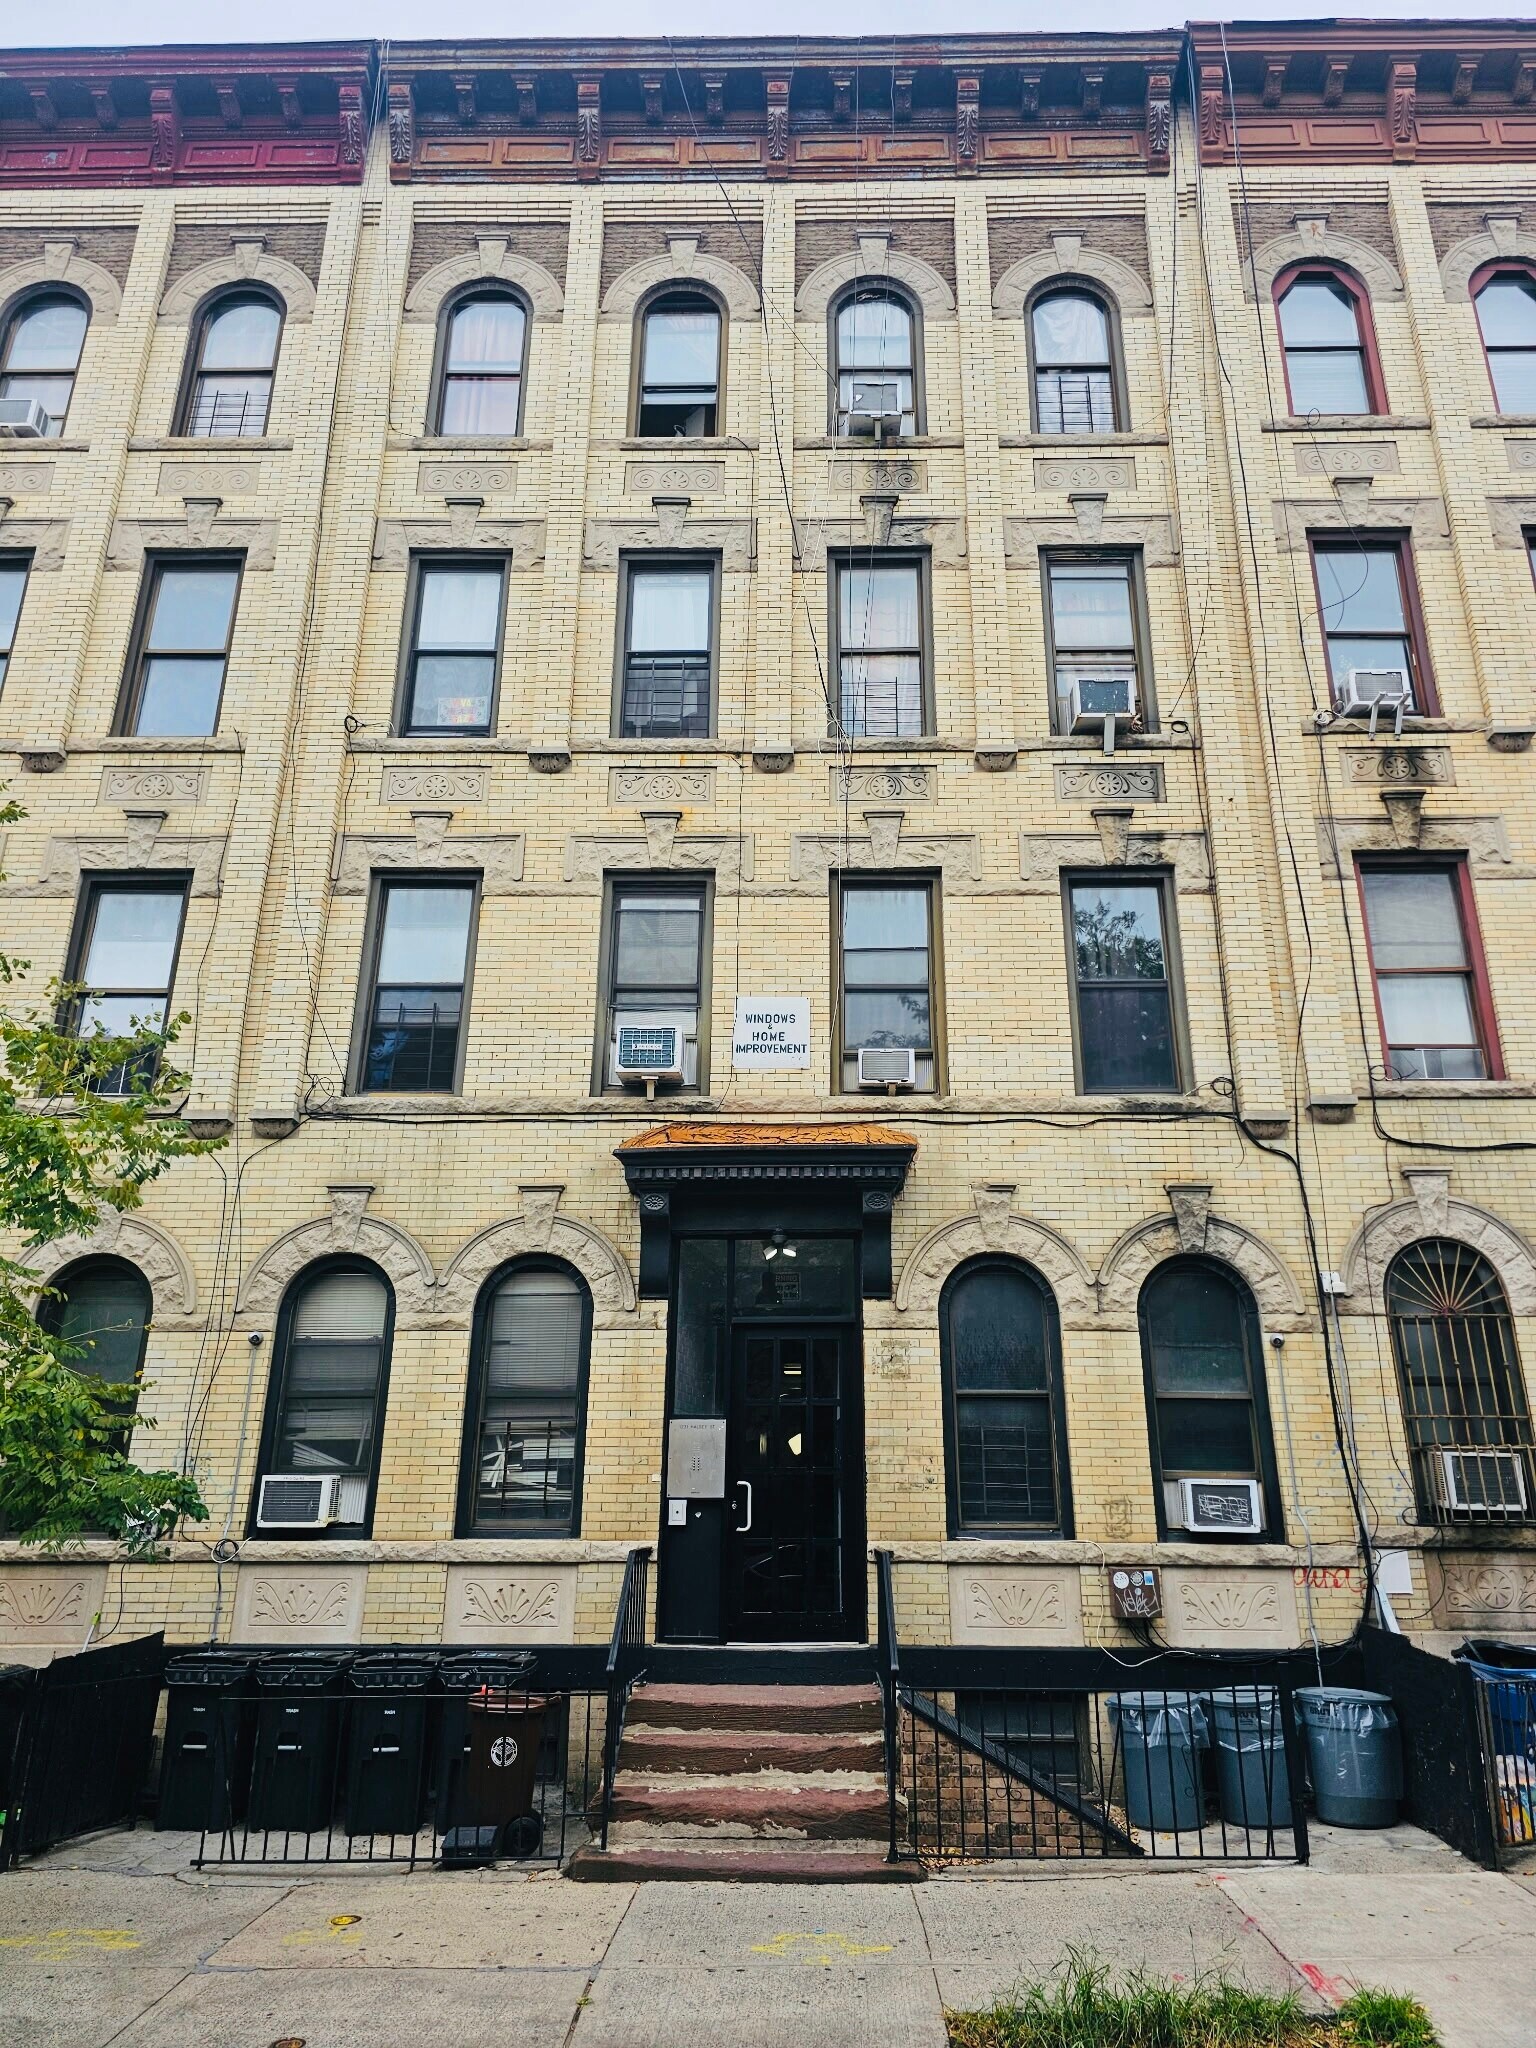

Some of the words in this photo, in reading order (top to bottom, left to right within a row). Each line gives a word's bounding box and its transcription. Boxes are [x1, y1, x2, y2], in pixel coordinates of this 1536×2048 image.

[745, 1013, 796, 1024] WINDOWS
[752, 1032, 785, 1042] HOME
[735, 1044, 807, 1054] IMPROVEMENT
